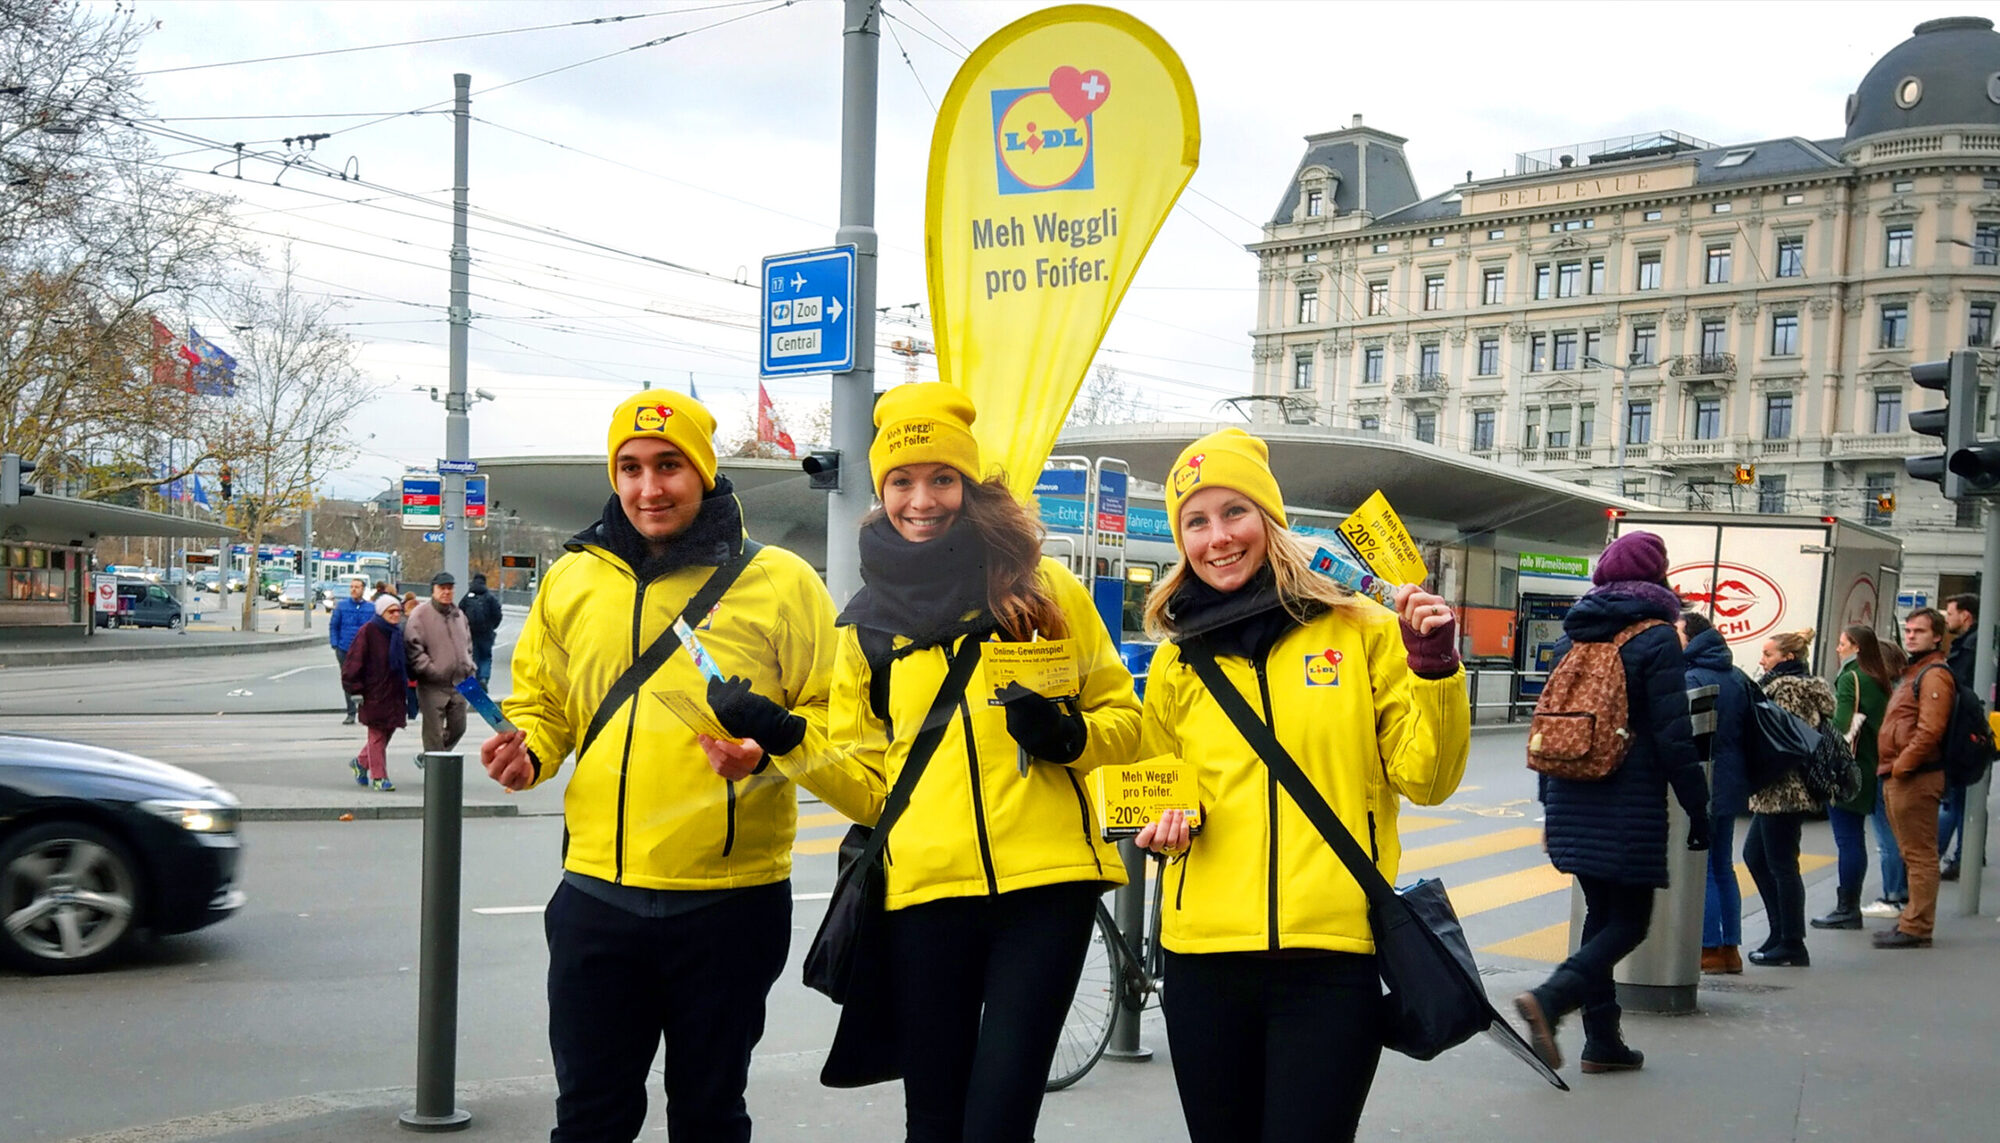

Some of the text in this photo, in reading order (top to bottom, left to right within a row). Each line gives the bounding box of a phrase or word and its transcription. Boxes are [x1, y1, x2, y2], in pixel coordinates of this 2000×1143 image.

[1499, 174, 1648, 207] BELLEVUE
[972, 207, 1118, 250] Meh Weggli
[773, 278, 783, 291] 17
[986, 256, 1109, 300] pro Foifer.
[797, 303, 818, 318] Zoo
[776, 332, 816, 352] Central
[904, 422, 935, 434] Weggli
[889, 441, 902, 454] pro
[1058, 506, 1077, 520] Echt
[1128, 513, 1153, 528] fahren
[430, 533, 444, 541] WC
[1347, 523, 1381, 560] -20%
[1371, 520, 1387, 537] pro
[1385, 536, 1407, 566] Foifer.
[1381, 510, 1398, 532] Meh
[1397, 531, 1418, 564] Weggli
[993, 644, 1064, 656] Online-Gewinnspiel
[1122, 770, 1179, 784] Meh Weggli
[1123, 786, 1173, 800] pro Foifer.
[1109, 806, 1150, 824] -20%
